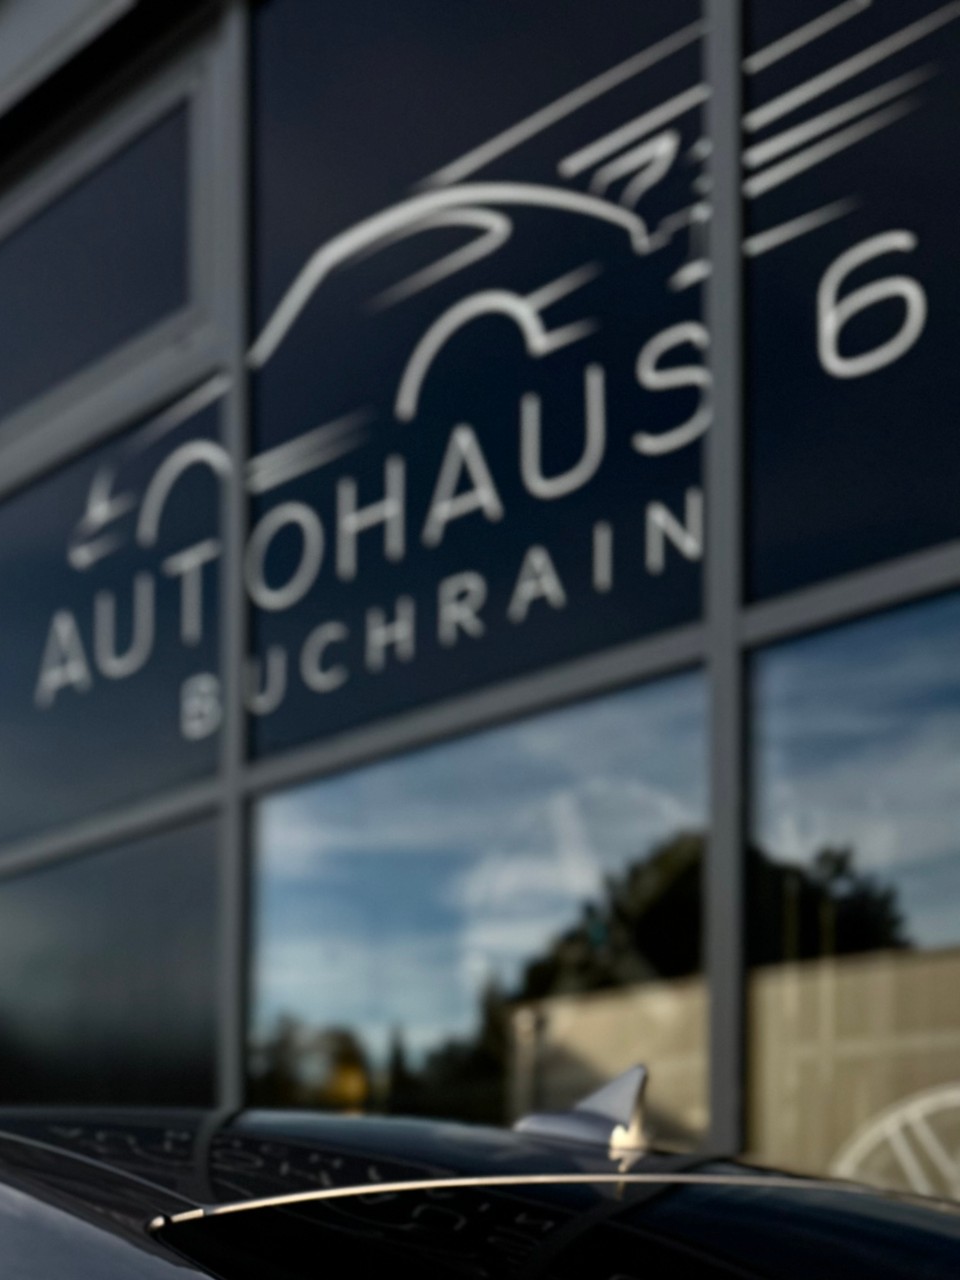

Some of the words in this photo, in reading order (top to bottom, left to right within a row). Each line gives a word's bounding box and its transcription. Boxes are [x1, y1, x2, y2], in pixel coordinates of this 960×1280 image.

[815, 229, 928, 380] 6
[34, 321, 715, 708] AUTOHAUS
[178, 486, 706, 742] BUCHRAIN
